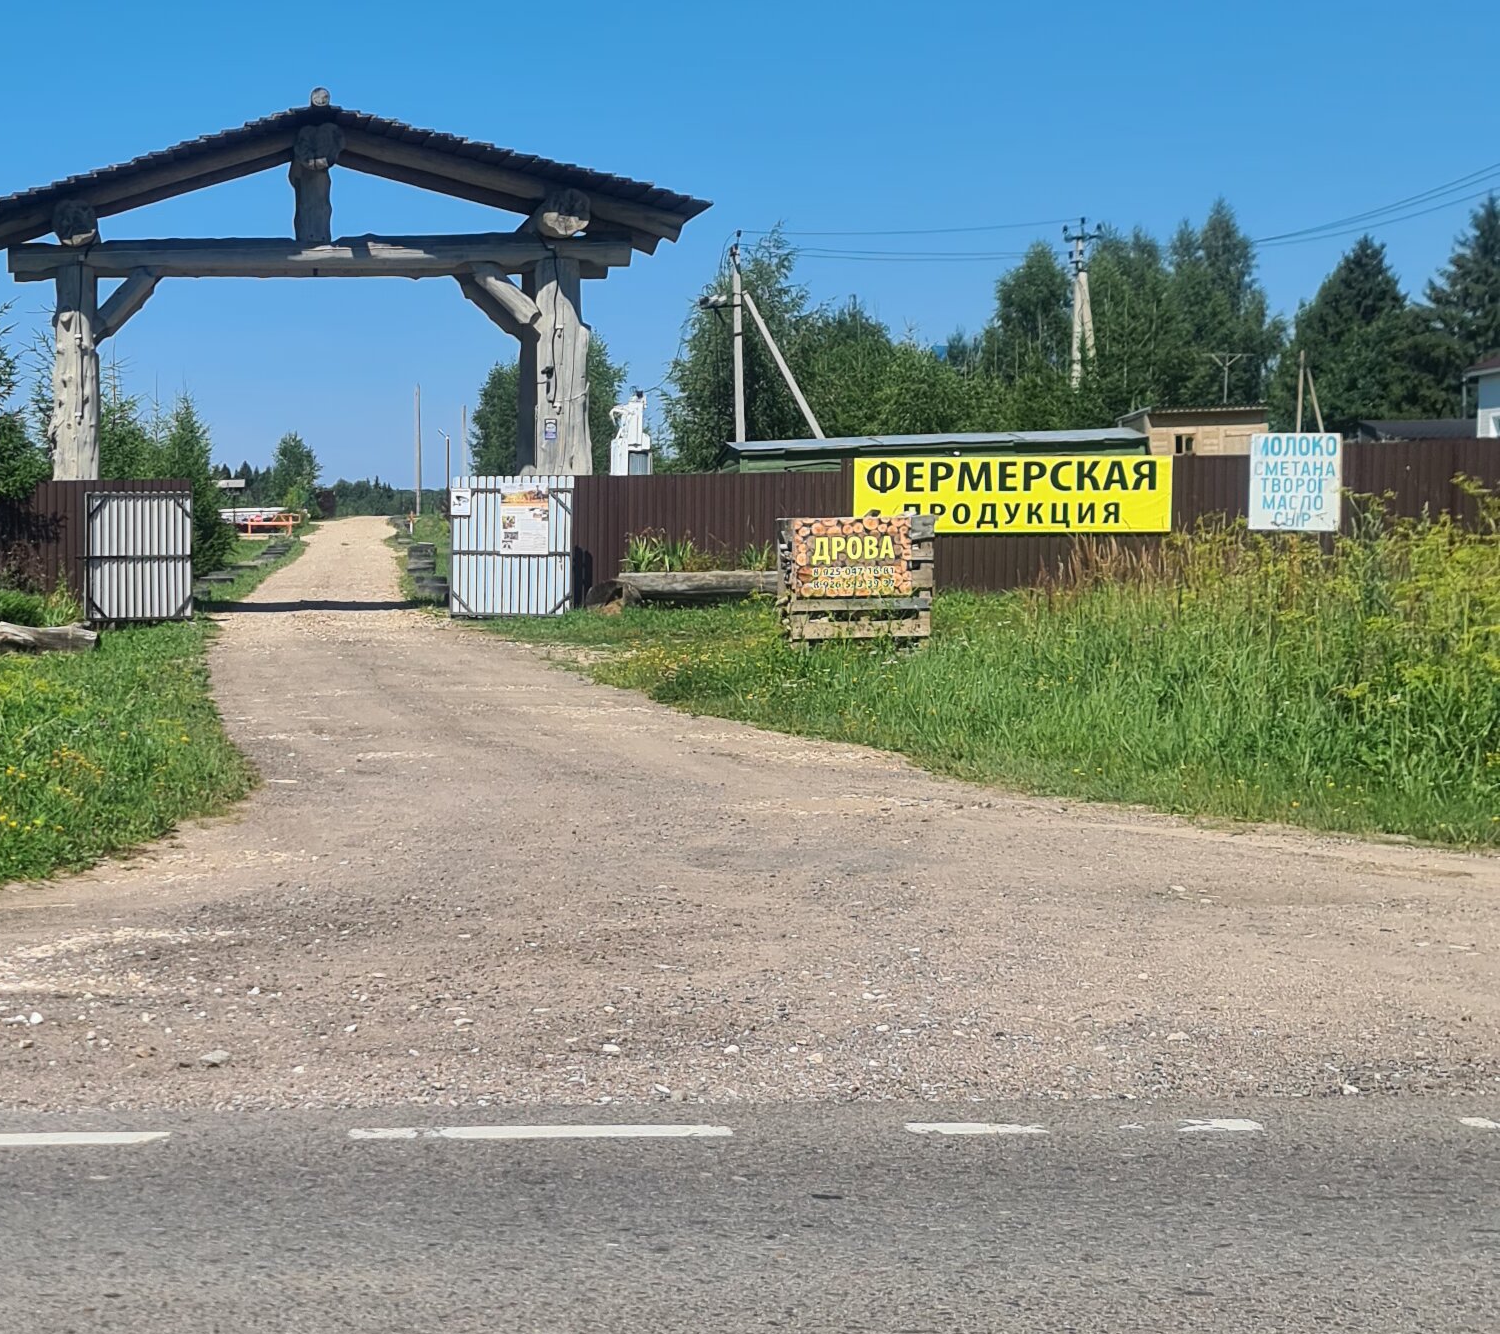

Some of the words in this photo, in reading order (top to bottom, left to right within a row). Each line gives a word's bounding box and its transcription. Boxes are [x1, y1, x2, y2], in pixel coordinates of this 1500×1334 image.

[1254, 435, 1337, 457] МОЛОКО
[866, 460, 1158, 493] ФЕРМЕРСКАЯ
[1254, 460, 1336, 477] СМЕТАНА
[1260, 477, 1328, 494] ТВОРОГ
[1262, 495, 1324, 511] МАСЛО
[1274, 511, 1311, 527] СЫР
[811, 535, 895, 566] ДРОВА
